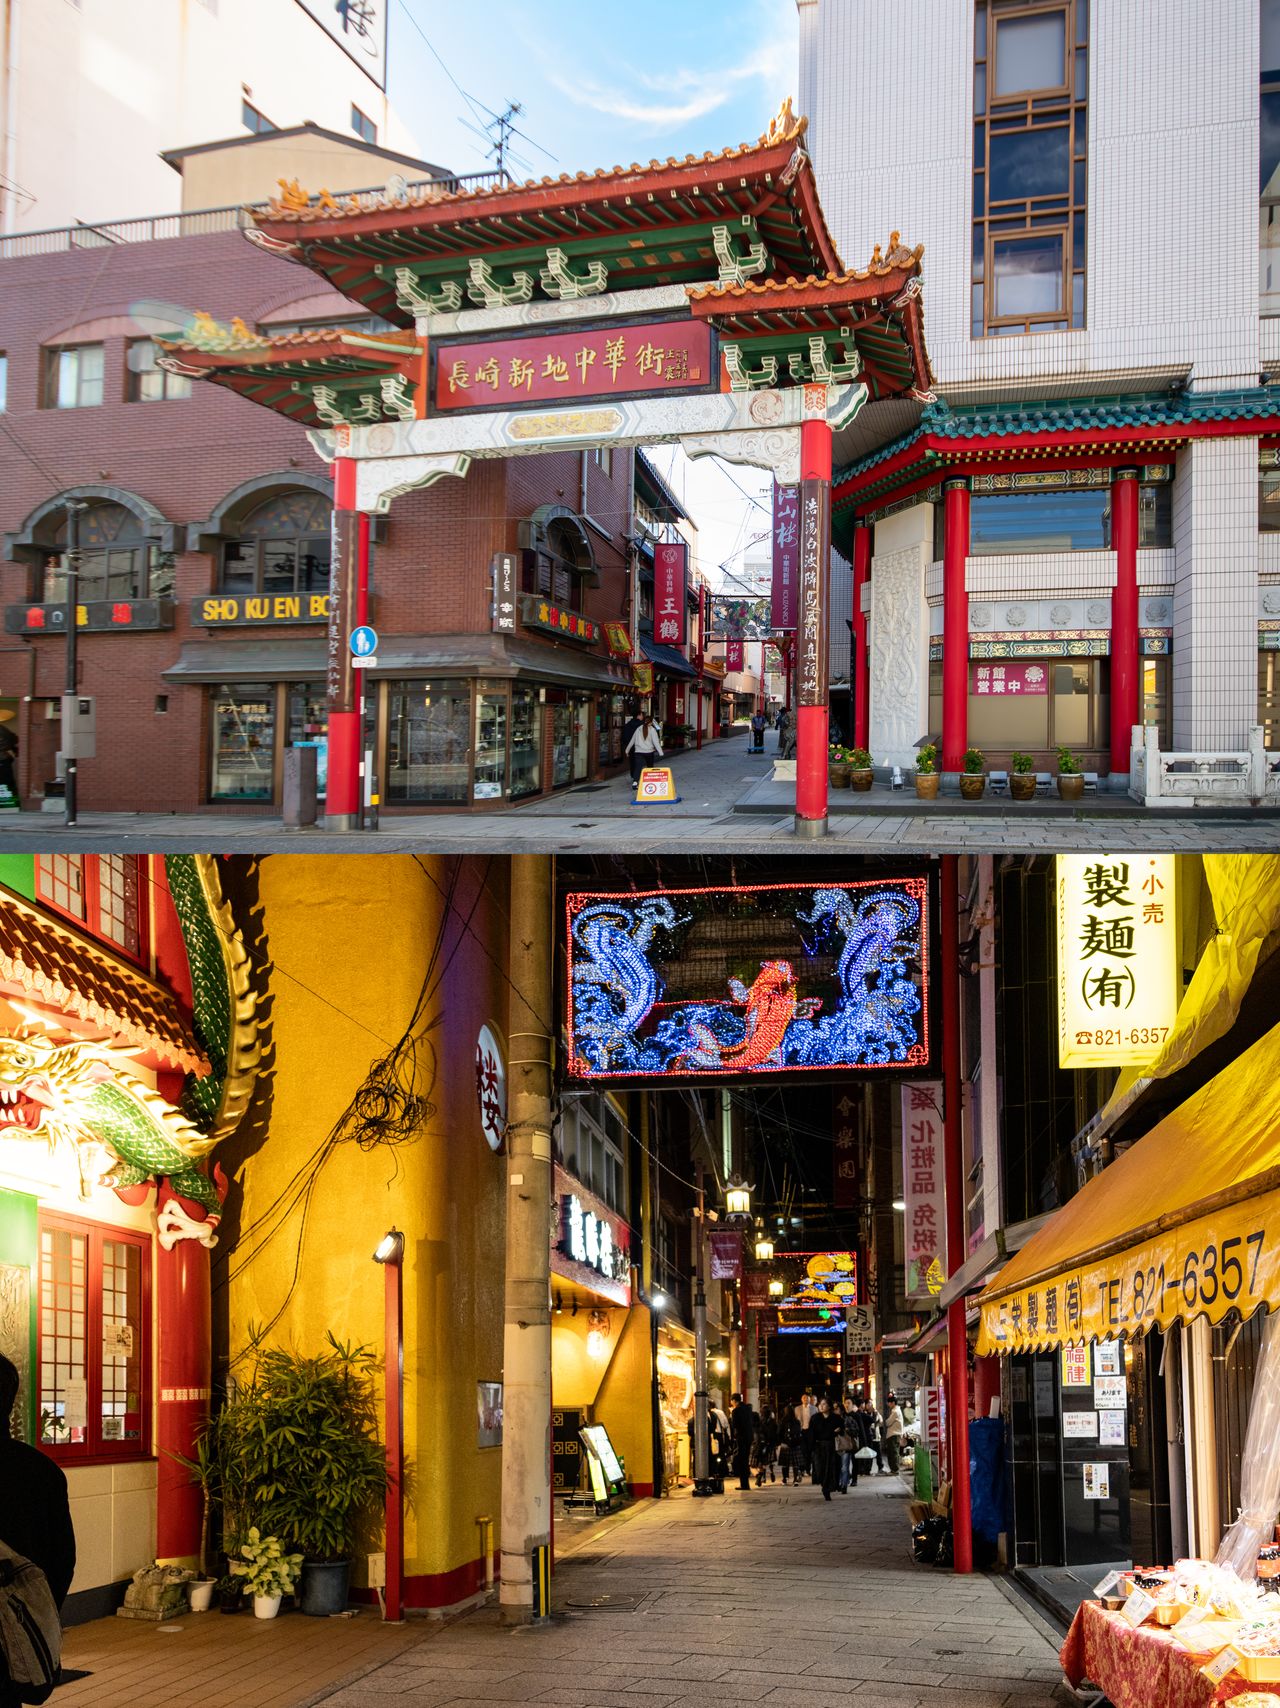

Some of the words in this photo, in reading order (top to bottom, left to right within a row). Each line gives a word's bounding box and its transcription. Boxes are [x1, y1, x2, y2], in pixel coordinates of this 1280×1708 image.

[448, 335, 665, 393] 長崎新地中華街
[202, 599, 239, 620] SHO
[245, 598, 269, 618] KU
[274, 597, 299, 618] EN
[659, 598, 679, 640] 王鶴
[977, 666, 1006, 680] 新館
[977, 680, 1021, 693] 営業中
[1094, 1027, 1169, 1046] 821-6357
[1099, 1278, 1129, 1326] TEL
[1133, 1230, 1265, 1321] 821-6357
